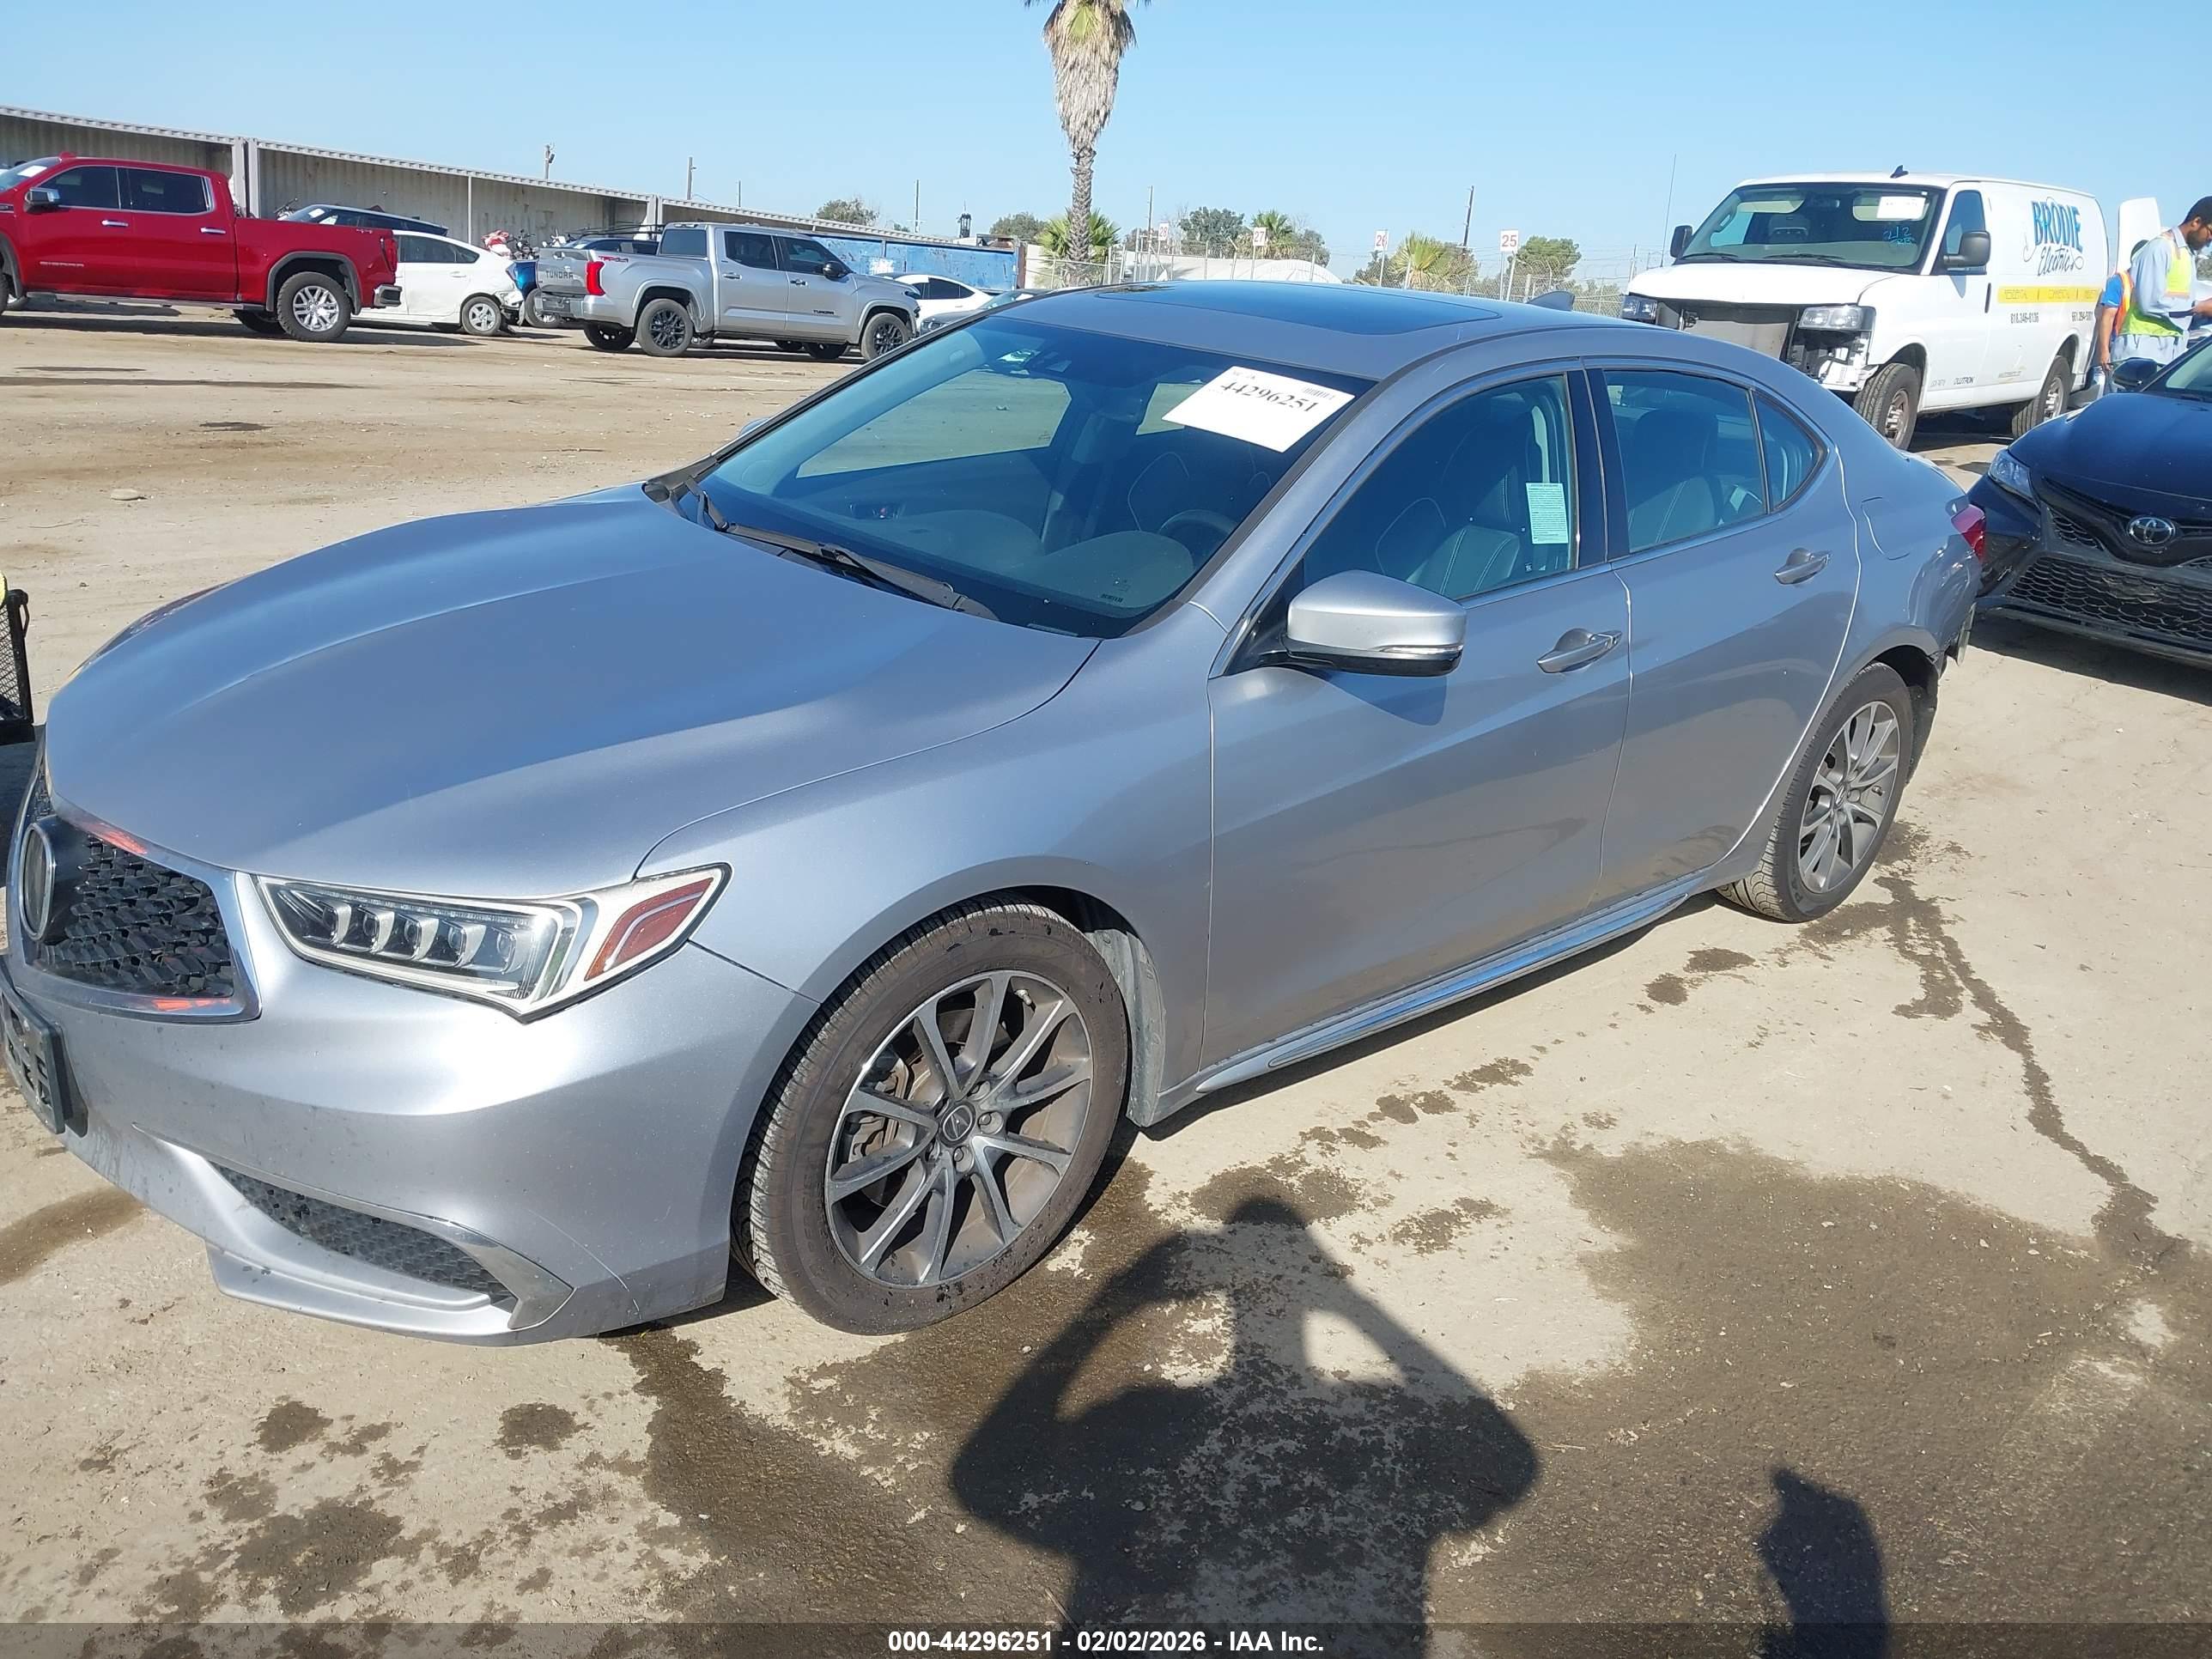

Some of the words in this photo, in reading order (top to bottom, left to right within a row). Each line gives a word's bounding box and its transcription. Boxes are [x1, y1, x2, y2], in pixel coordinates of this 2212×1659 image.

[1160, 226, 1168, 236] 28
[2031, 201, 2083, 253] BRODIE
[1255, 231, 1265, 240] 27
[1376, 234, 1387, 247] 26
[1502, 234, 1517, 247] 25
[545, 270, 574, 279] TUNDRA
[1220, 381, 1319, 412] 44296251
